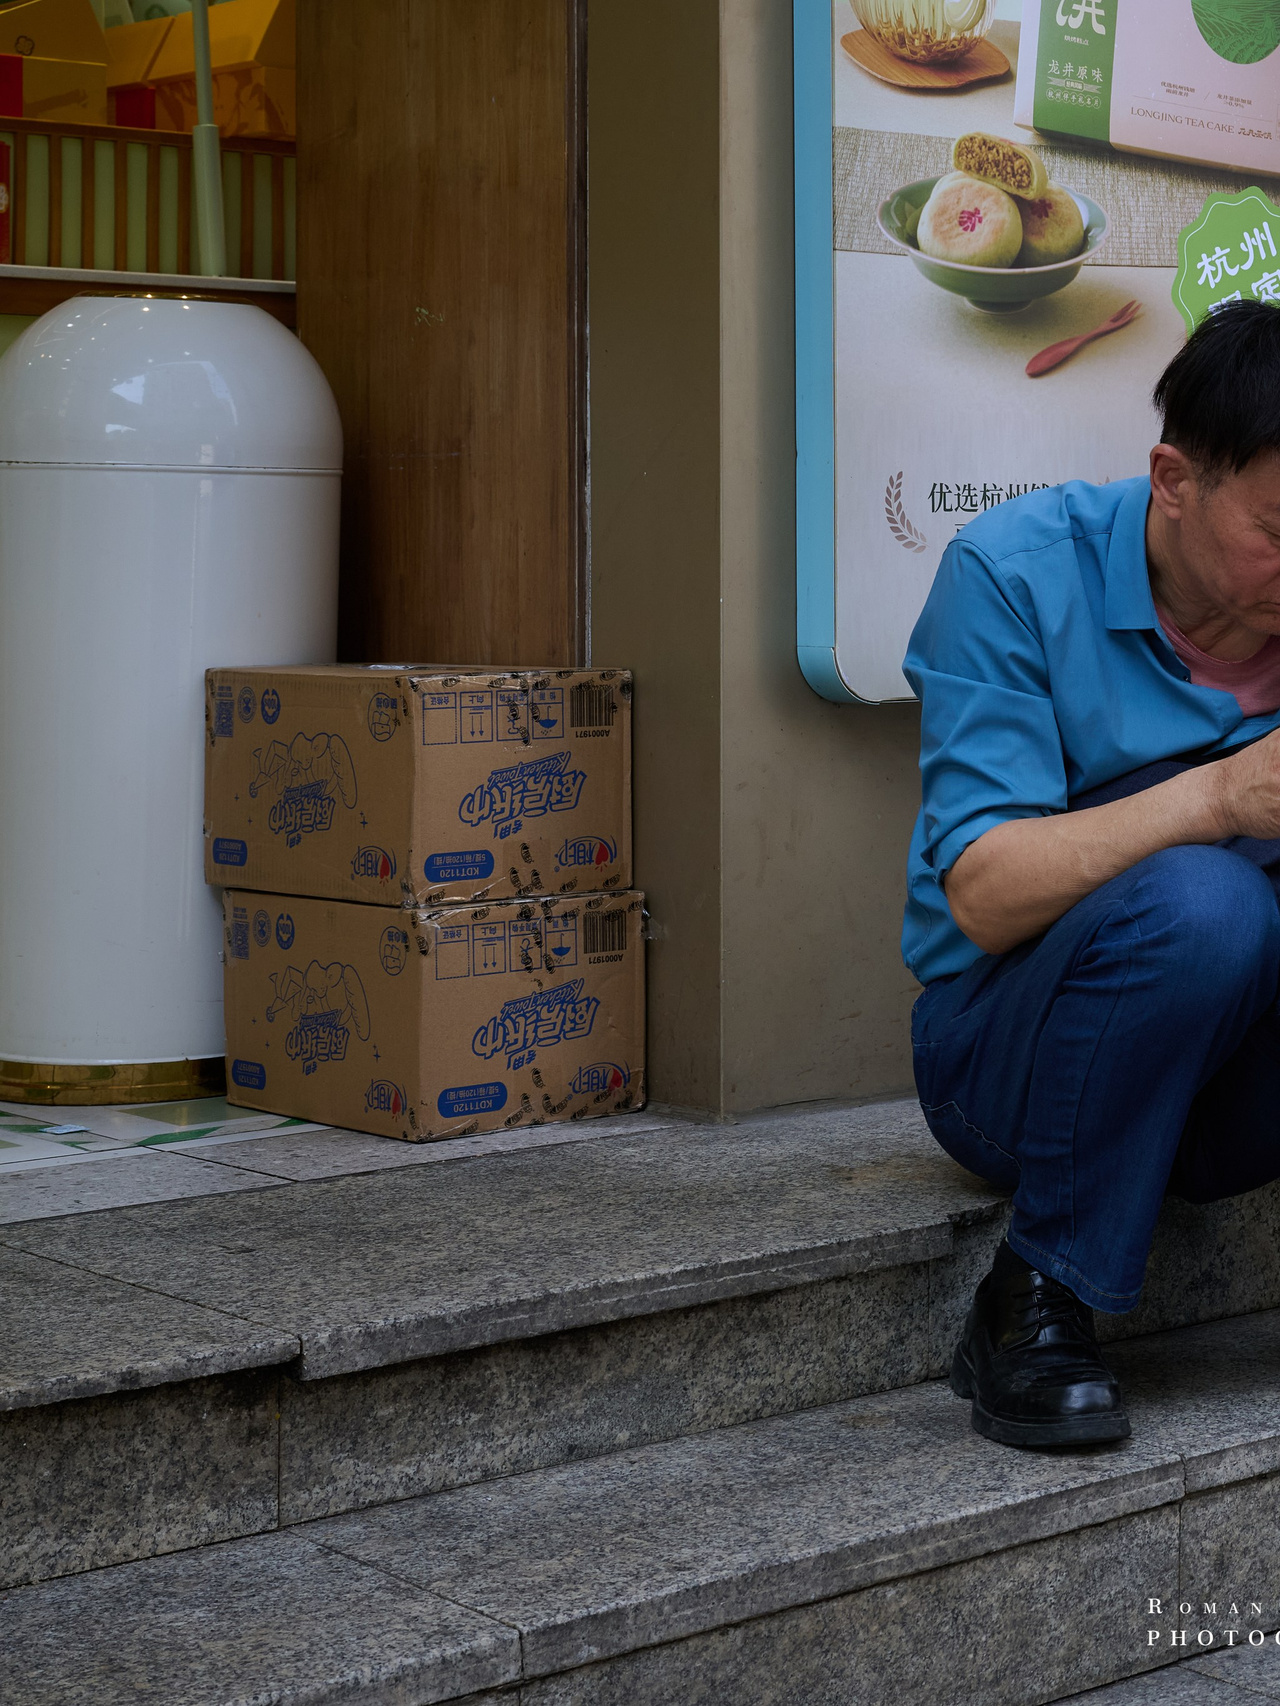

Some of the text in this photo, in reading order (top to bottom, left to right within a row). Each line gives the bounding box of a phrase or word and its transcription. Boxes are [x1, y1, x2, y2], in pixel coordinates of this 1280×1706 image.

[1047, 59, 1104, 83] 龙井原味
[1130, 106, 1183, 124] LONGJING
[1184, 116, 1206, 129] TEA
[1206, 119, 1235, 134] CAKE
[1196, 221, 1279, 291] 杭州
[927, 482, 1060, 514] 优选杭州
[430, 695, 450, 706] 合格证
[468, 694, 485, 705] 向上
[575, 728, 611, 739] A0001971
[486, 751, 571, 788] Kitchen Towel
[457, 771, 587, 828] 厨房纸巾
[268, 796, 336, 836] 厨房纸巾
[493, 820, 523, 840] 专用
[439, 865, 480, 878] KDT1120
[442, 929, 463, 939] 合格证
[481, 926, 497, 937] 向上
[587, 954, 624, 966] A0001971
[499, 977, 585, 1020] Kitchen Towel
[471, 997, 601, 1061] 厨房纸巾
[285, 1026, 350, 1064] 厨房纸巾
[506, 1049, 537, 1071] 专用
[452, 1099, 494, 1113] KDT1120
